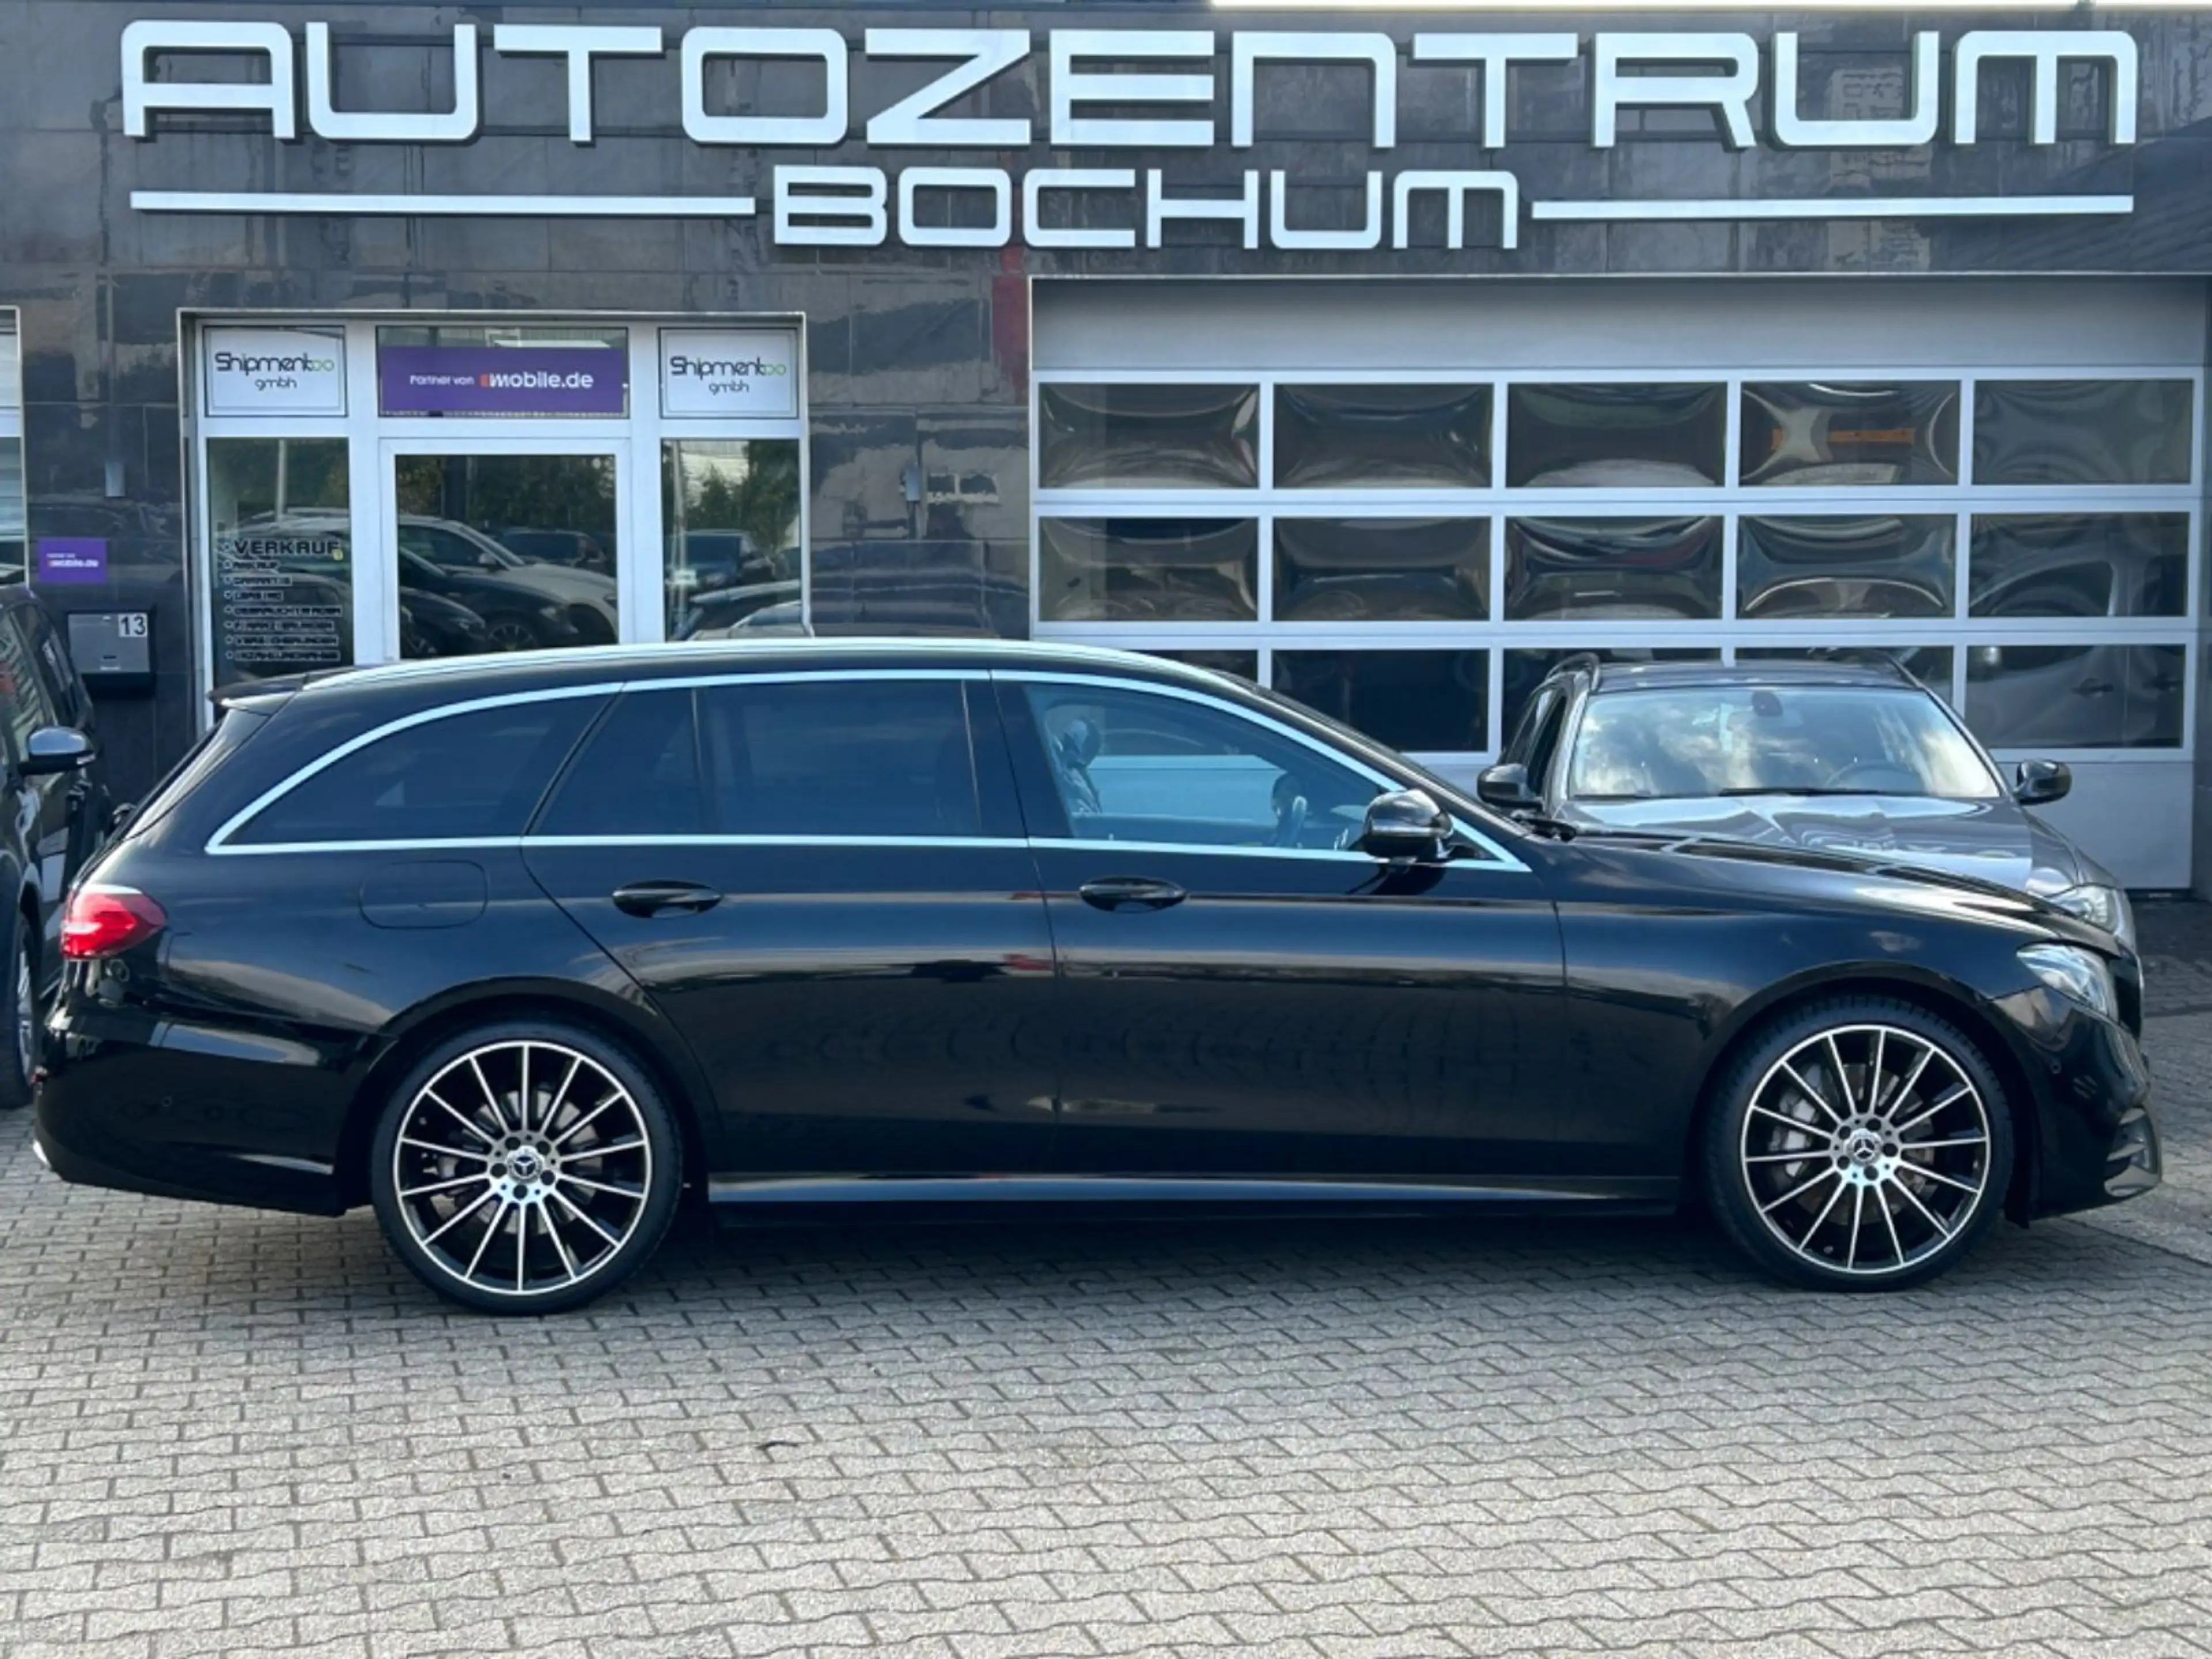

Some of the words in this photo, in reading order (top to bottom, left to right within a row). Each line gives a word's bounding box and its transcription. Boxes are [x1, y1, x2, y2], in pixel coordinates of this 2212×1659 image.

[122, 21, 2138, 147] AUTOZENTRUM
[774, 165, 1518, 250] BOCHUM
[410, 375, 450, 385] Partner
[453, 376, 475, 385] von
[490, 372, 593, 388] mobile.de
[233, 539, 340, 556] VERKAUF
[120, 616, 146, 635] 13
